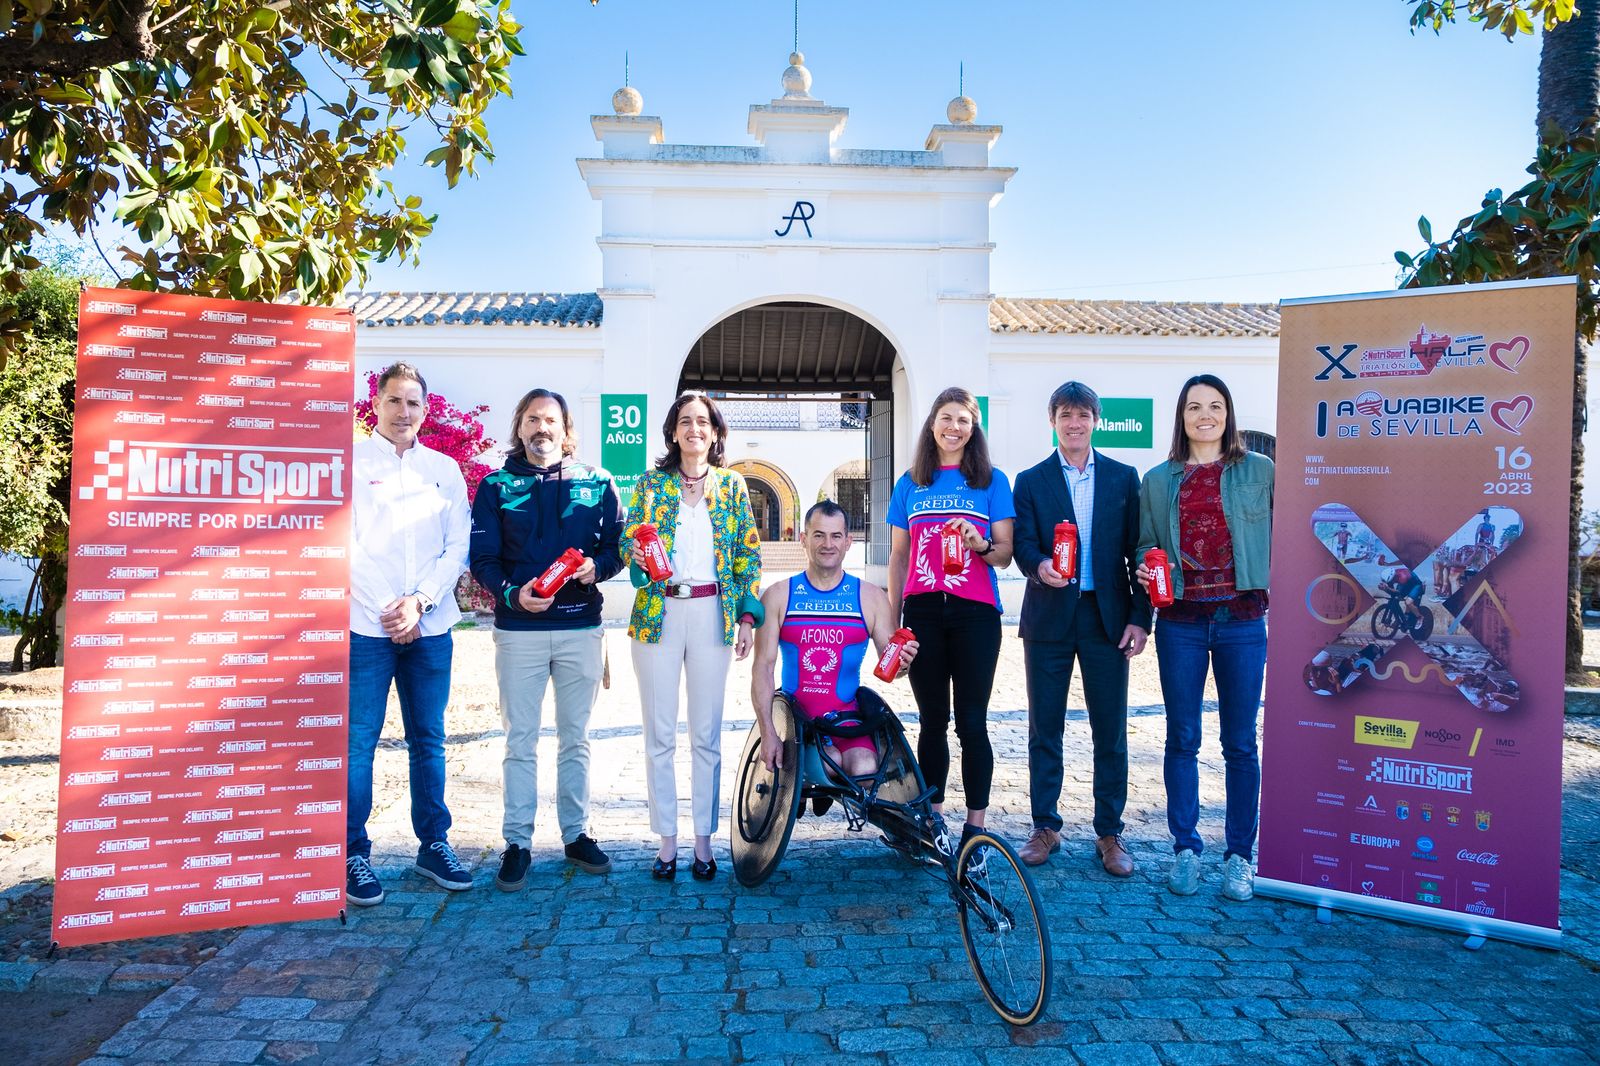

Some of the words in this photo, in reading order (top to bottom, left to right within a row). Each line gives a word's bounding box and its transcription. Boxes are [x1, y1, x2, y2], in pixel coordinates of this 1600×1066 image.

[1368, 350, 1406, 360] NutriSport
[1314, 344, 1358, 380] X
[1427, 357, 1486, 368] SEVILLA
[1337, 392, 1485, 417] AQUABIKE
[608, 406, 641, 428] 30
[1096, 418, 1142, 432] Alamillo
[1338, 425, 1360, 437] DE
[1370, 418, 1483, 436] SEVILLA
[606, 431, 643, 444] AÑOS
[1305, 455, 1325, 463] WWW.
[1495, 446, 1532, 470] 16
[1305, 466, 1392, 474] HALFTRIATLONDESEVILLA.
[1500, 472, 1532, 480] ABRIL
[127, 449, 344, 505] NutriSport
[1304, 477, 1319, 485] COM
[1483, 482, 1532, 494] 2023
[913, 499, 974, 511] CREDUS
[108, 511, 192, 528] SIEMPRE
[199, 514, 237, 528] POR
[244, 514, 324, 530] DELANTE
[795, 602, 852, 611] CREDUS
[800, 628, 844, 644] AFONSO
[1496, 738, 1515, 747] IMD
[1384, 761, 1472, 790] NutriSport
[1465, 904, 1495, 916] HORIZON
